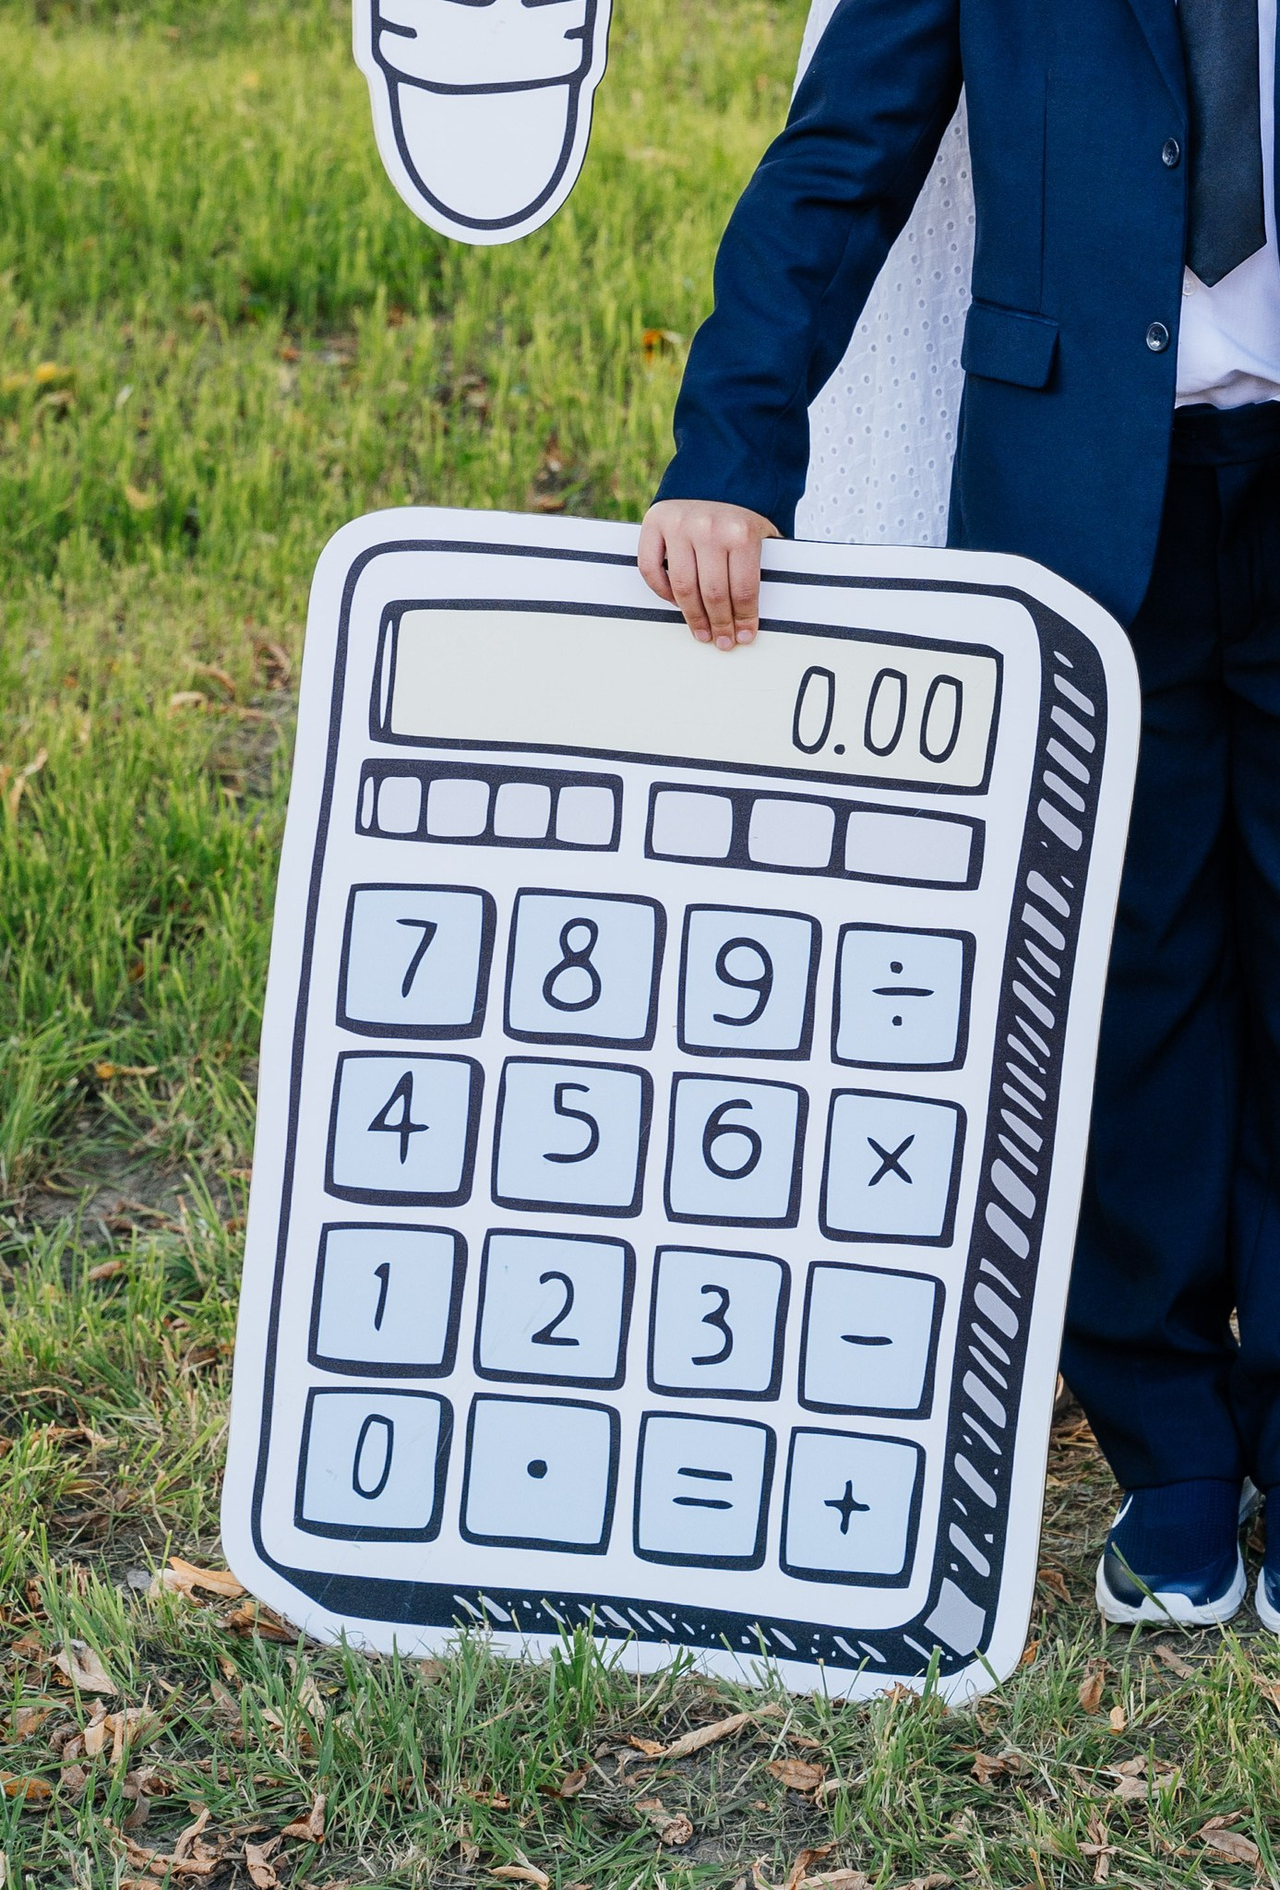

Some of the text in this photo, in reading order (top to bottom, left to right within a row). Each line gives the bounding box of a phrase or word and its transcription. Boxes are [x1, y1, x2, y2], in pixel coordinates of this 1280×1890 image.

[791, 665, 964, 764] 0.00
[395, 918, 438, 999] 7
[542, 917, 602, 1013] 8
[712, 936, 774, 1027] 9
[366, 1070, 430, 1165] 4
[542, 1082, 600, 1164] 5
[701, 1098, 763, 1180] 6
[373, 1262, 391, 1332] 1
[531, 1270, 580, 1347] 2
[691, 1284, 734, 1366] 3
[352, 1413, 395, 1500] 0
